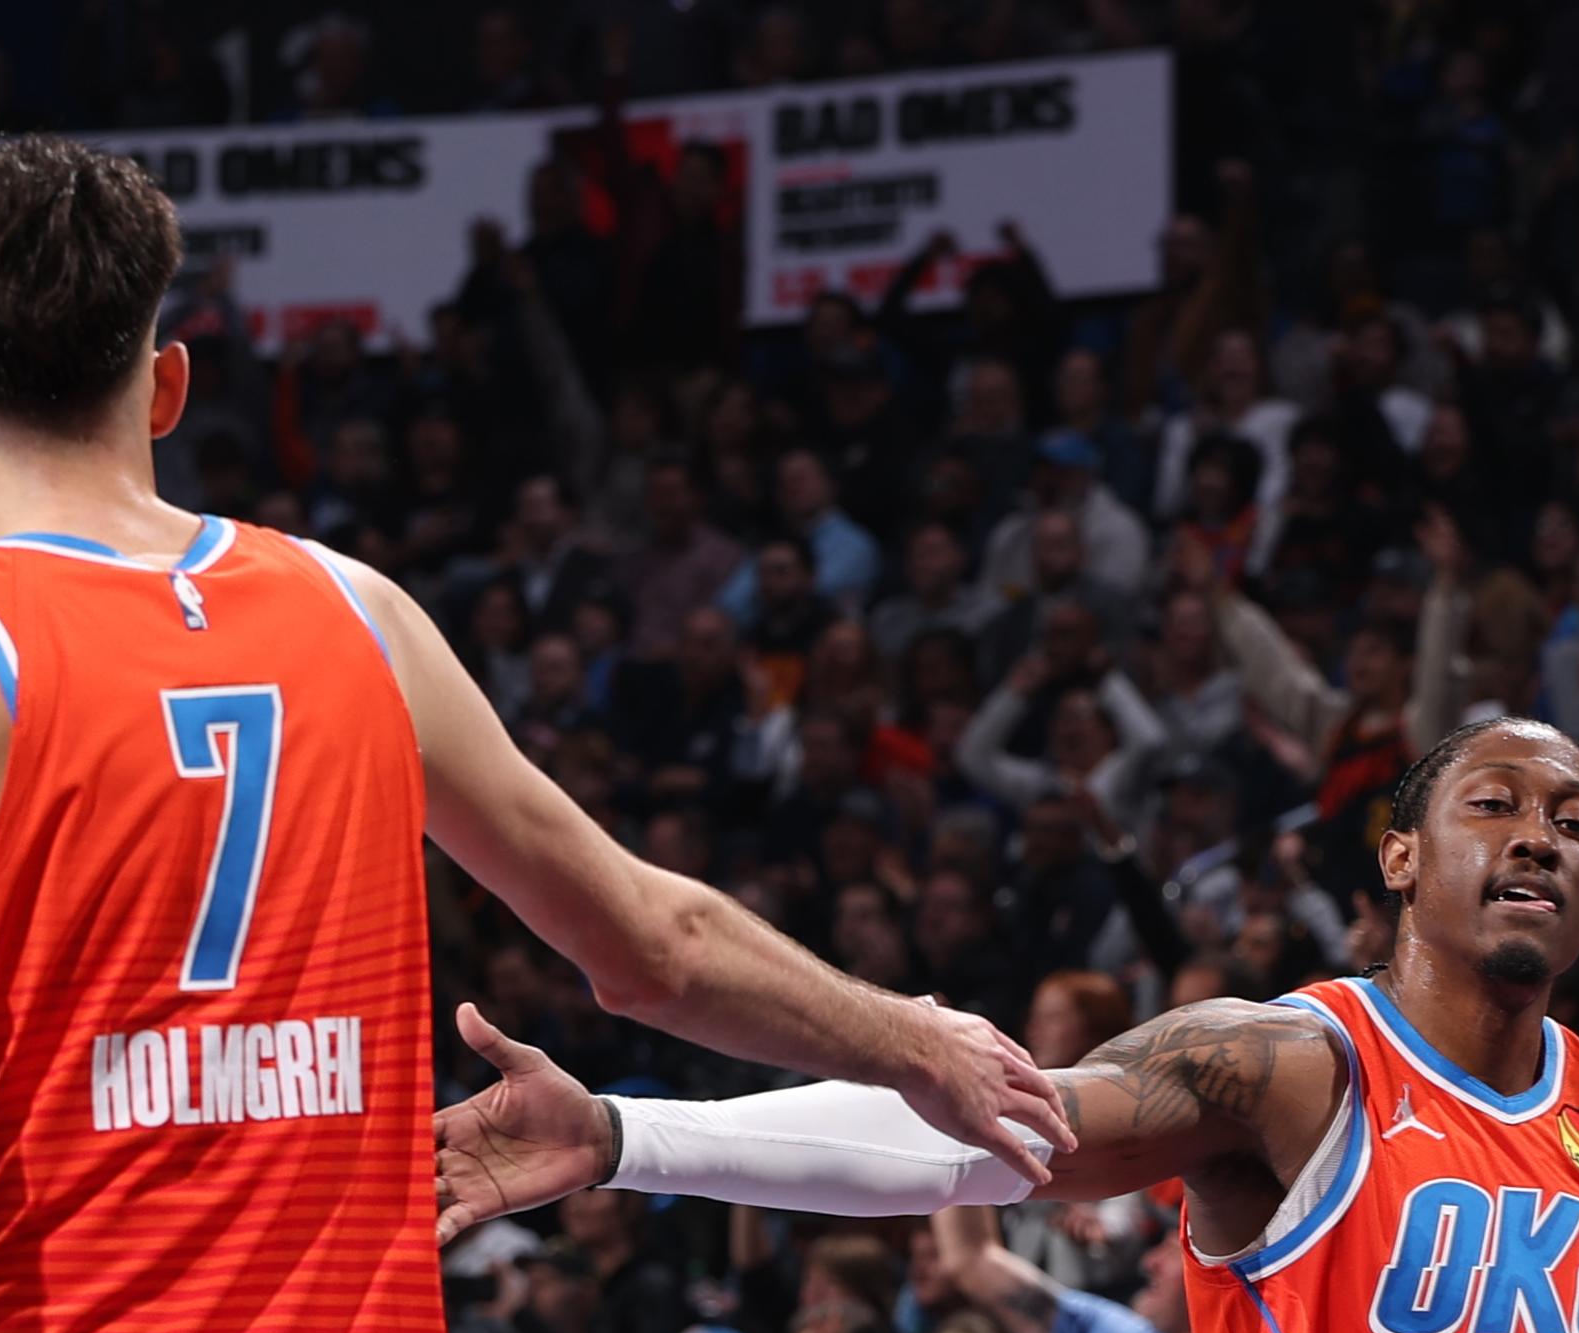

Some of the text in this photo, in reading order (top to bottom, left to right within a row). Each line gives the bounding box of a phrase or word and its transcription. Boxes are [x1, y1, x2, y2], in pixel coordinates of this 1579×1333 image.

[775, 98, 881, 158] BAD
[159, 683, 284, 992] 7
[90, 1015, 365, 1132] HOLMGREN
